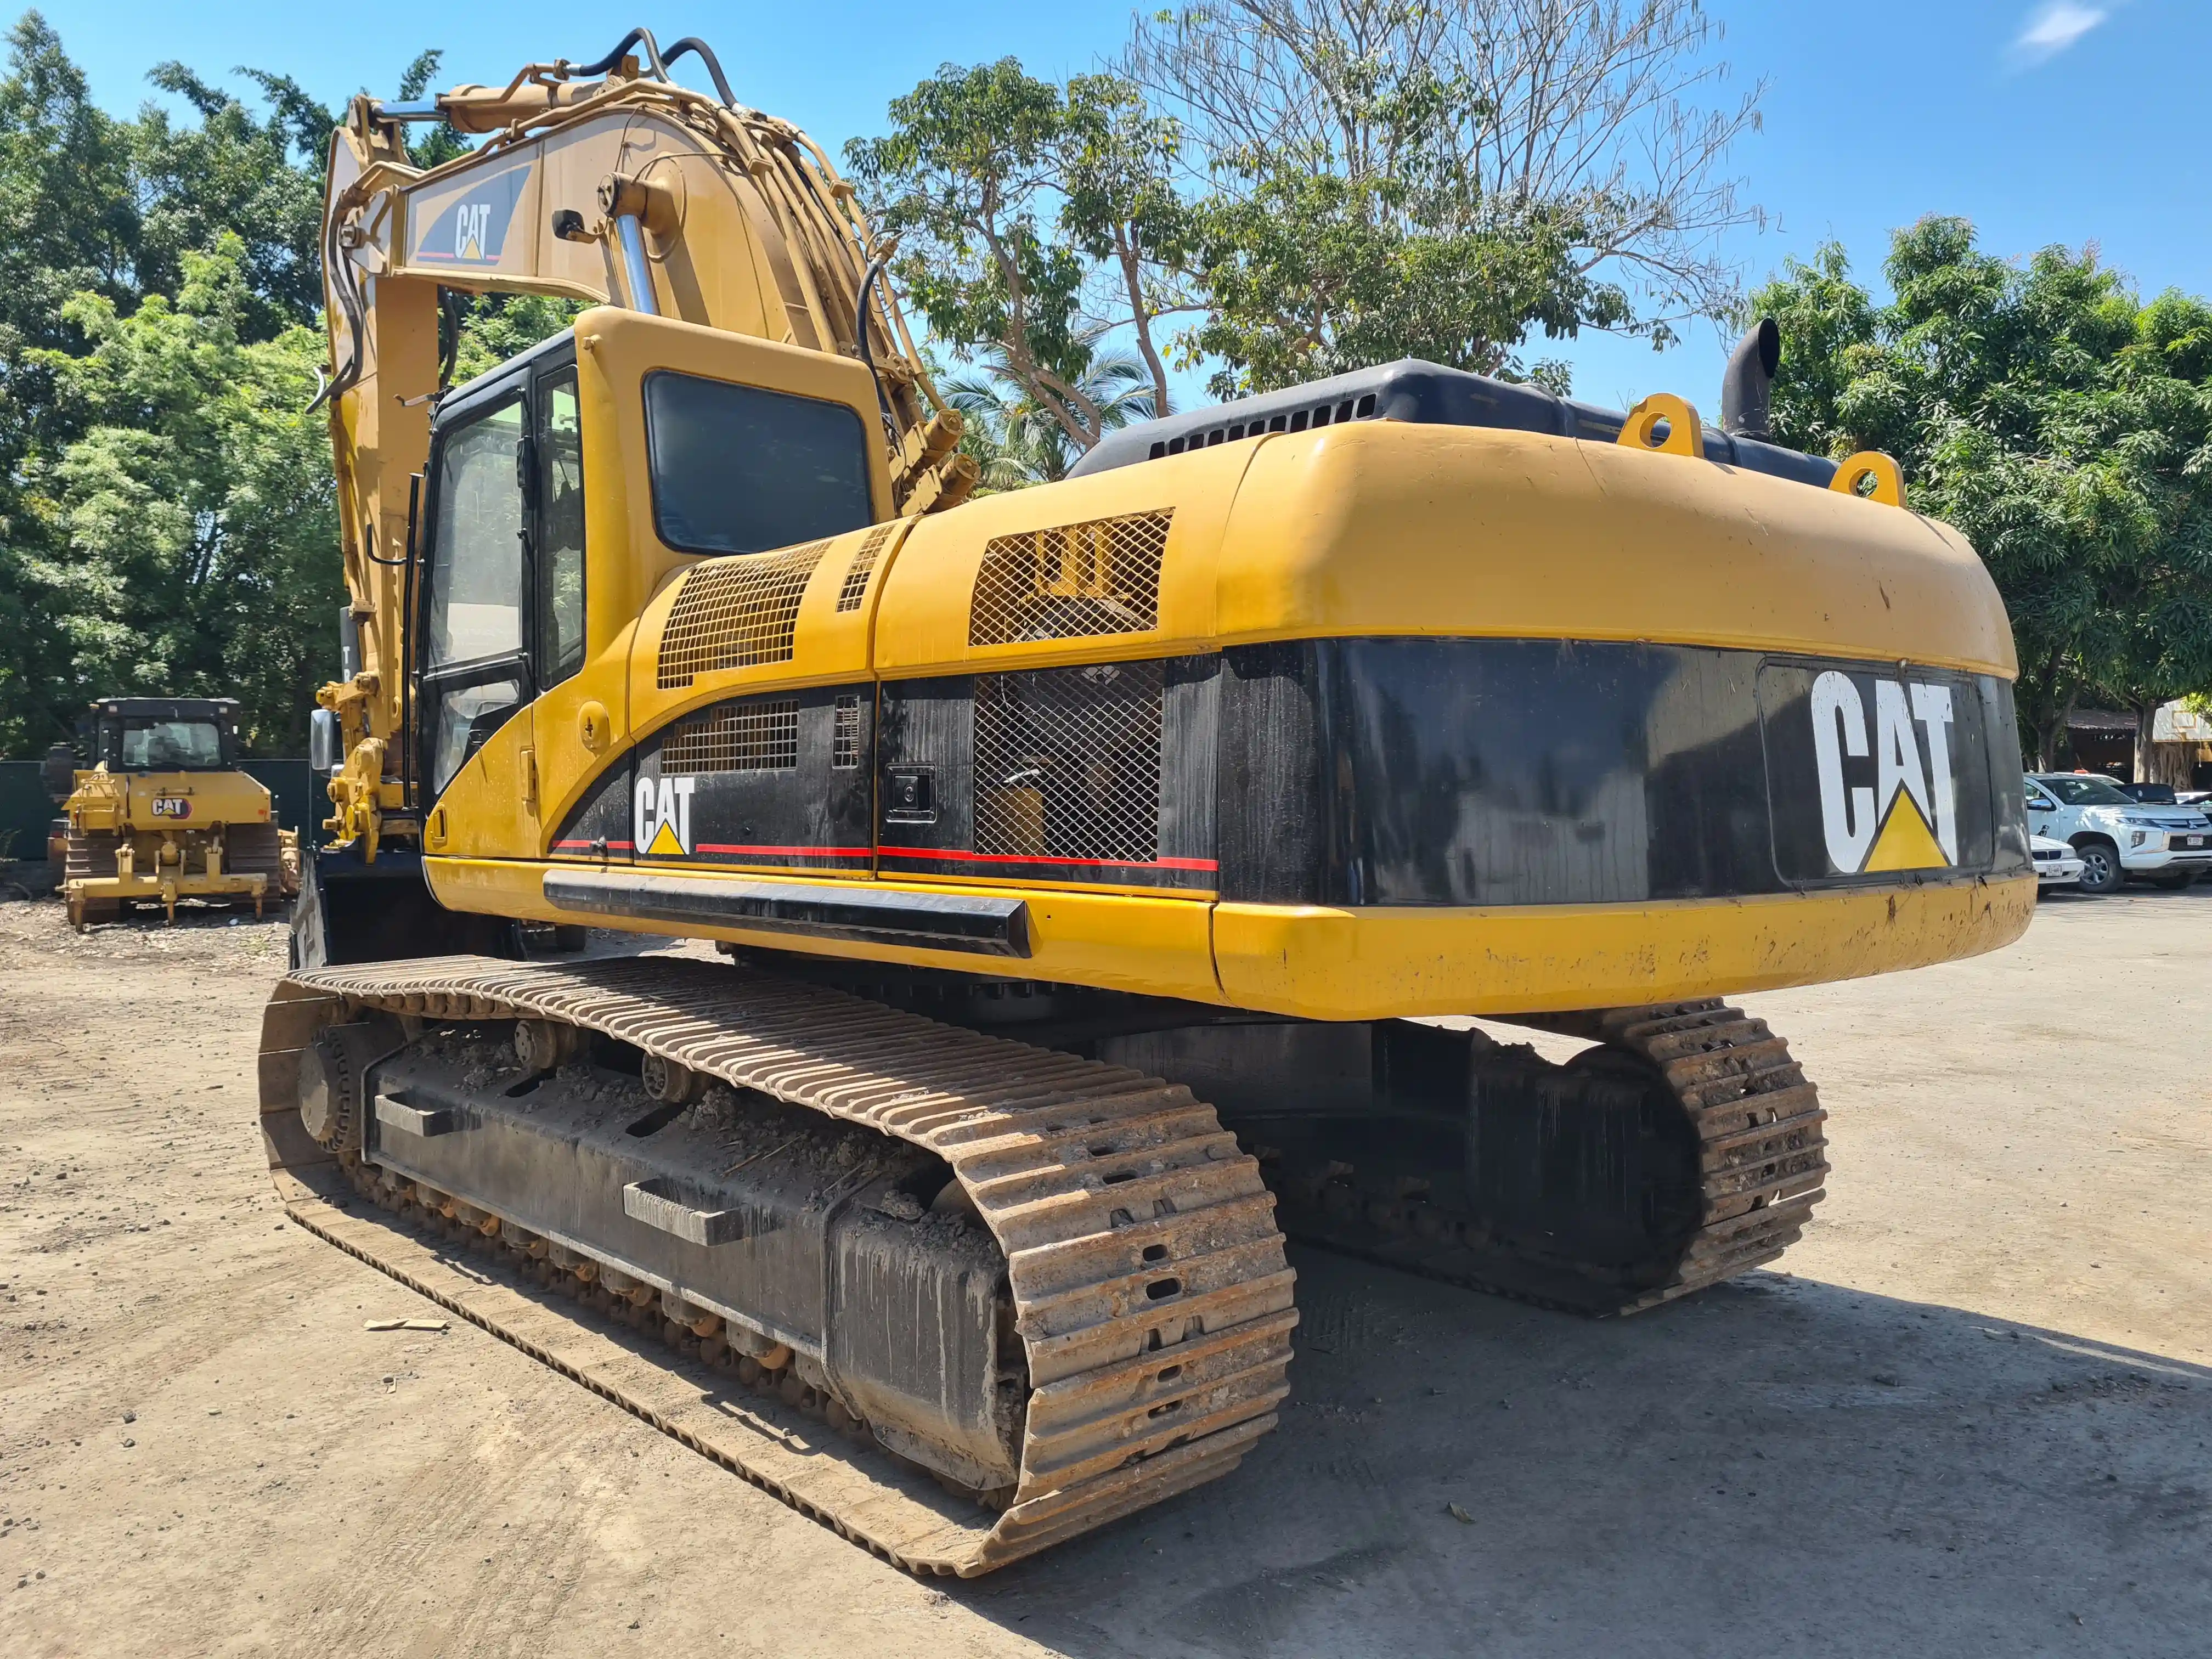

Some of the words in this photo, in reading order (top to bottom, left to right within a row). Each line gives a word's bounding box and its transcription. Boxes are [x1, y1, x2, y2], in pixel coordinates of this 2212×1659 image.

[455, 204, 490, 259] CAT
[1811, 670, 1958, 873] CAT
[152, 799, 183, 815] CAT
[635, 777, 695, 855] CAT
